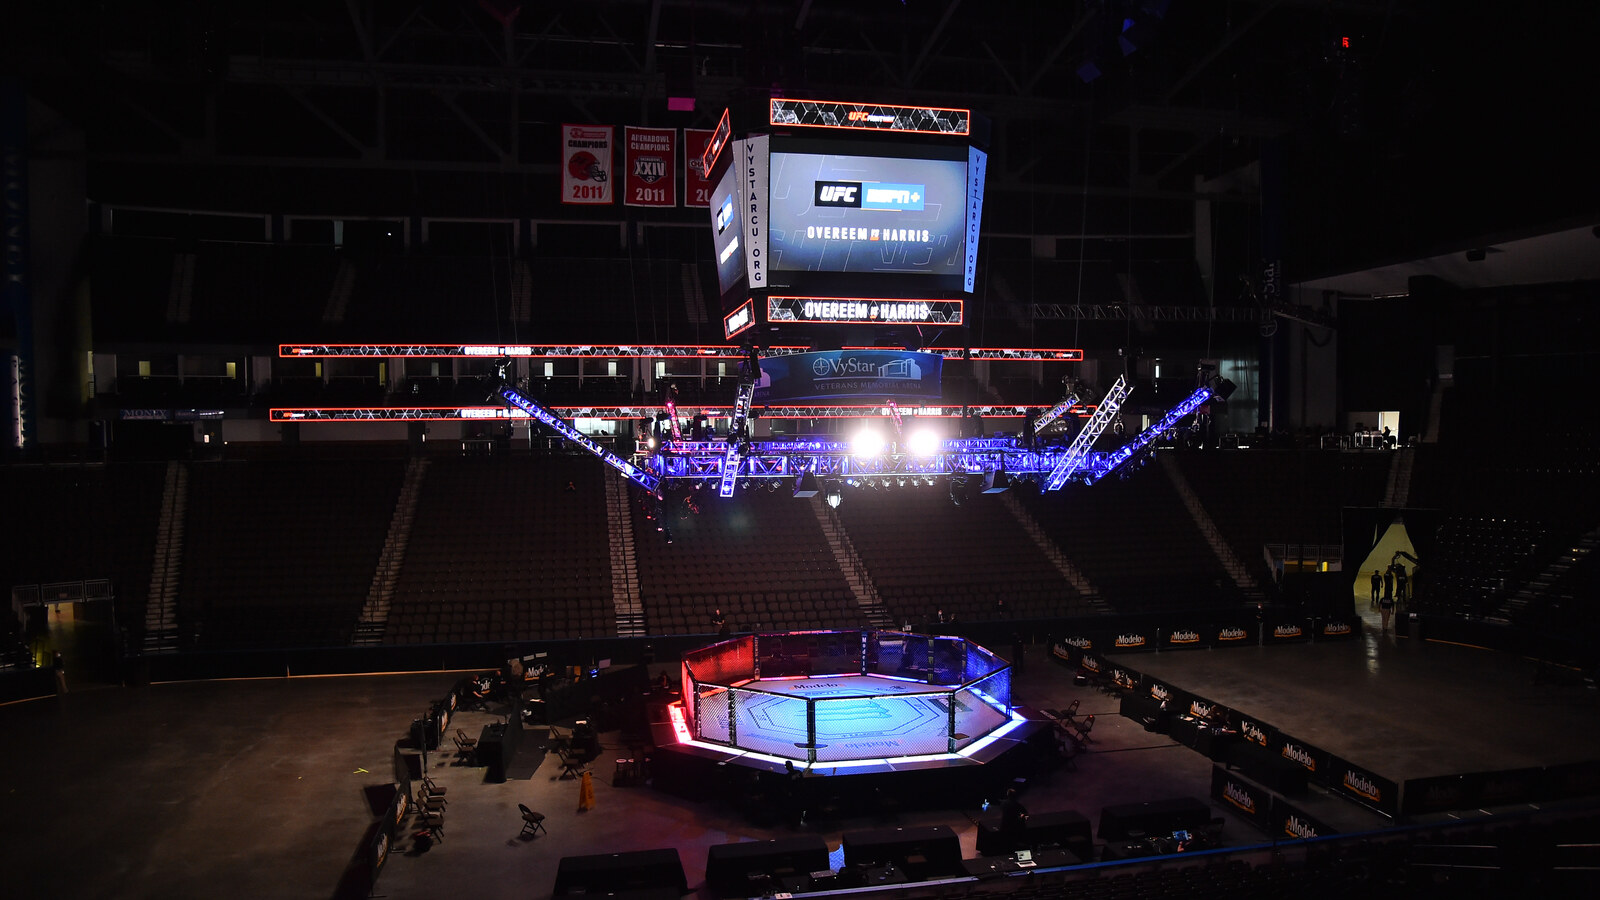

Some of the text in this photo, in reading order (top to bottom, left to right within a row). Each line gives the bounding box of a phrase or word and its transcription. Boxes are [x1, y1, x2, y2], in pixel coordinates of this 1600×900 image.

[848, 111, 869, 122] UFC
[568, 140, 608, 149] CHAMPIONS
[631, 134, 670, 143] ARENABOWL
[631, 142, 670, 151] CHAMPIONS
[634, 162, 666, 177] XXIV
[573, 185, 603, 199] 2011
[635, 188, 666, 202] 2011
[820, 185, 858, 203] UFC
[807, 226, 868, 241] OVEREEM
[882, 228, 929, 242] HARRIS
[804, 302, 868, 319] OVEREEM
[880, 304, 929, 320] HARRIS
[829, 358, 875, 377] VyStar
[815, 382, 858, 391] VETERANS
[1118, 635, 1142, 645] Modelo
[1173, 631, 1197, 641] Modelo
[1153, 684, 1168, 698] Model
[1286, 743, 1313, 767] Modelo
[1348, 770, 1377, 796] Modelo
[1227, 781, 1252, 808] Modelo
